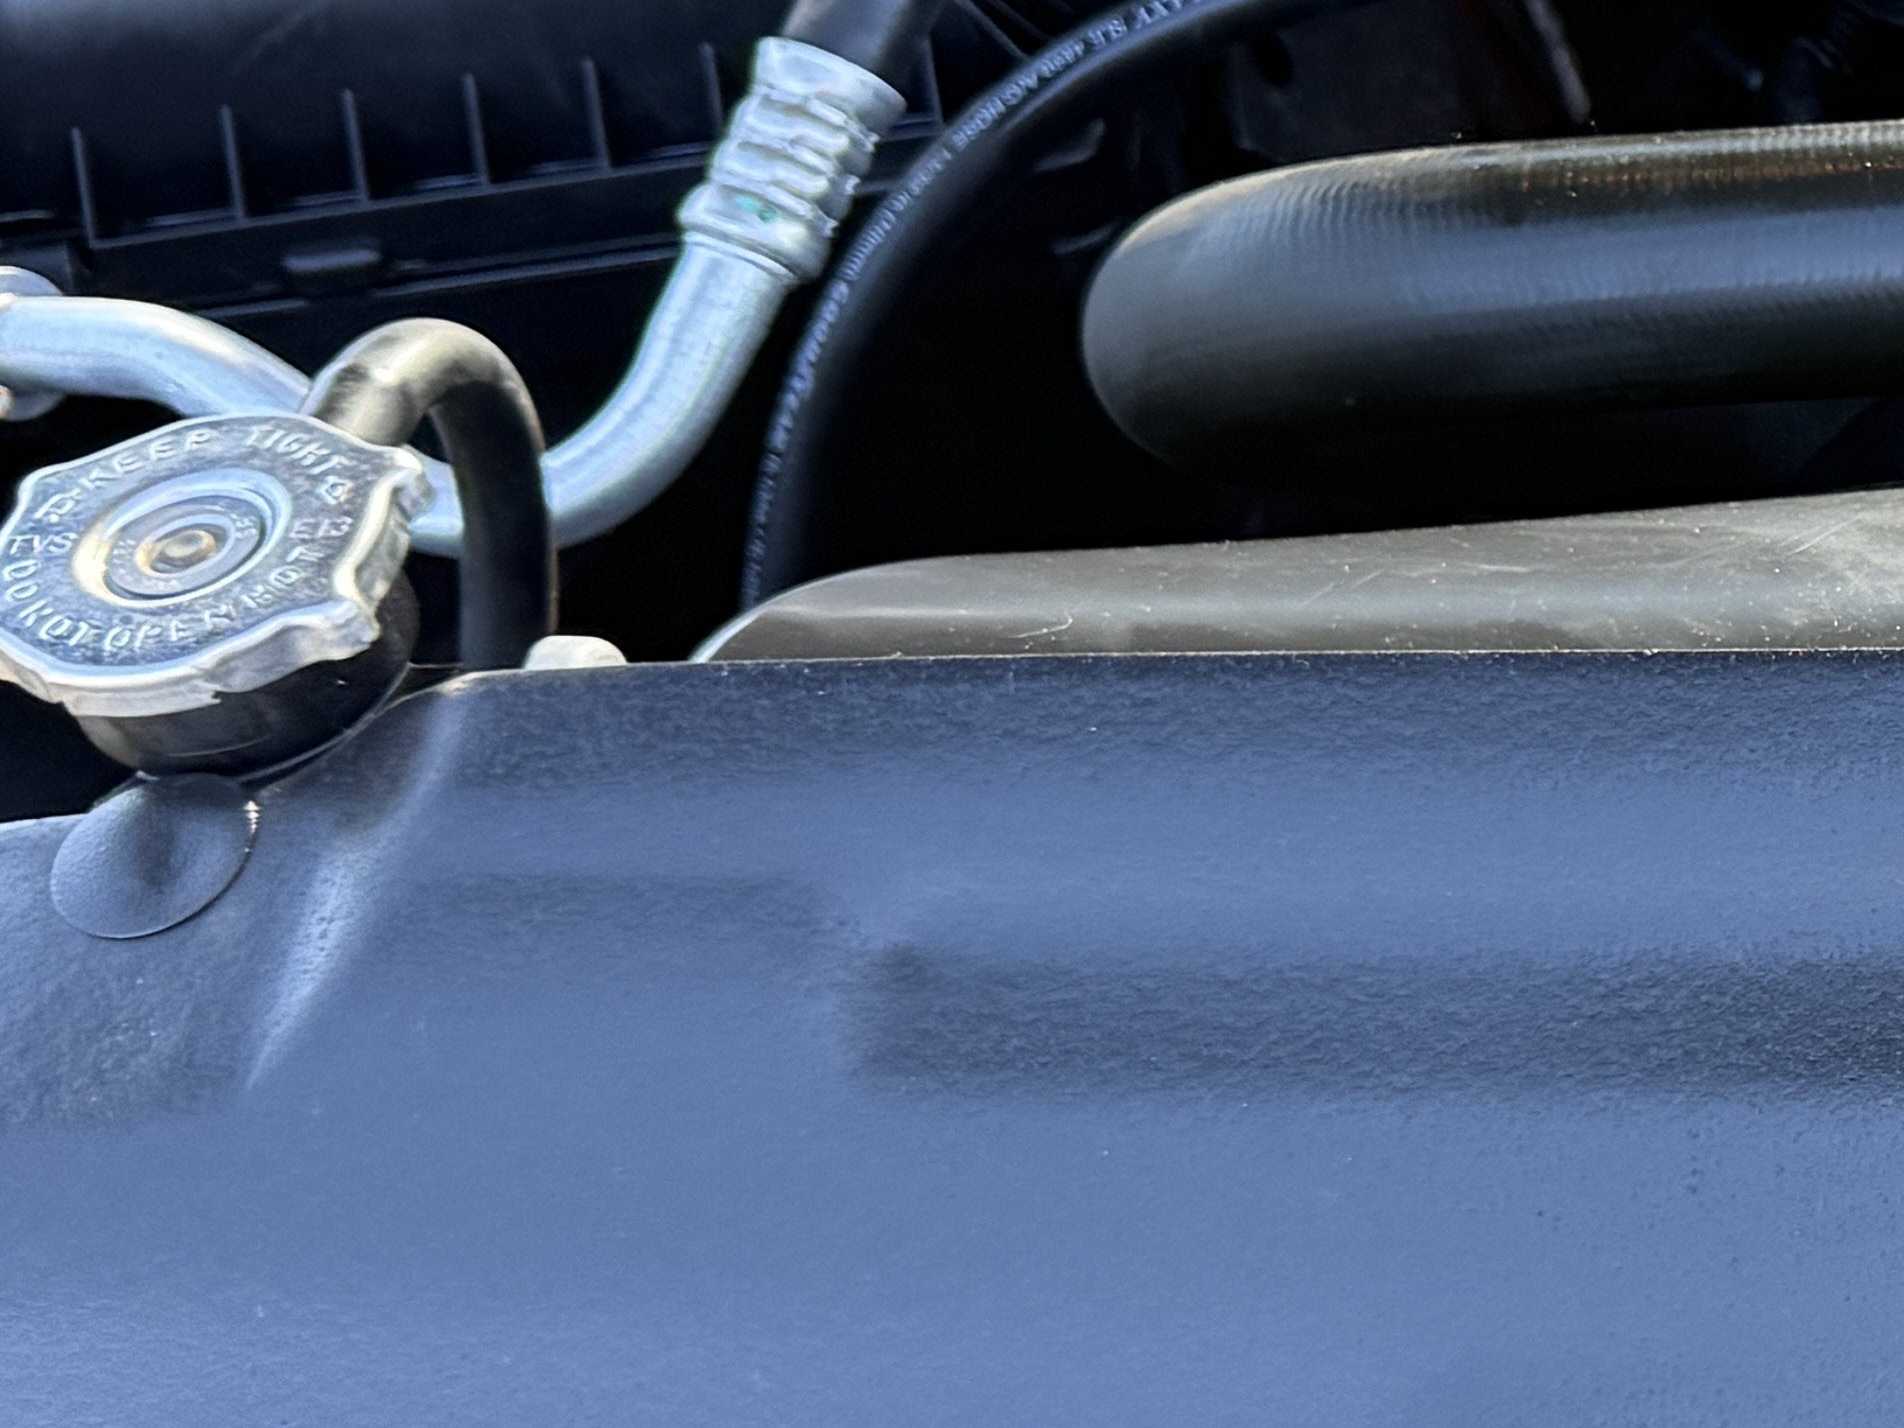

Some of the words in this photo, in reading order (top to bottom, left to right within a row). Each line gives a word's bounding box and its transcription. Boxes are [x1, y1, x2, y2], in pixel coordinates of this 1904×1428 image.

[82, 427, 221, 491] KEEP
[243, 425, 349, 476] TIGHT
[9, 532, 79, 557] TVS
[103, 602, 236, 653] OPEN
